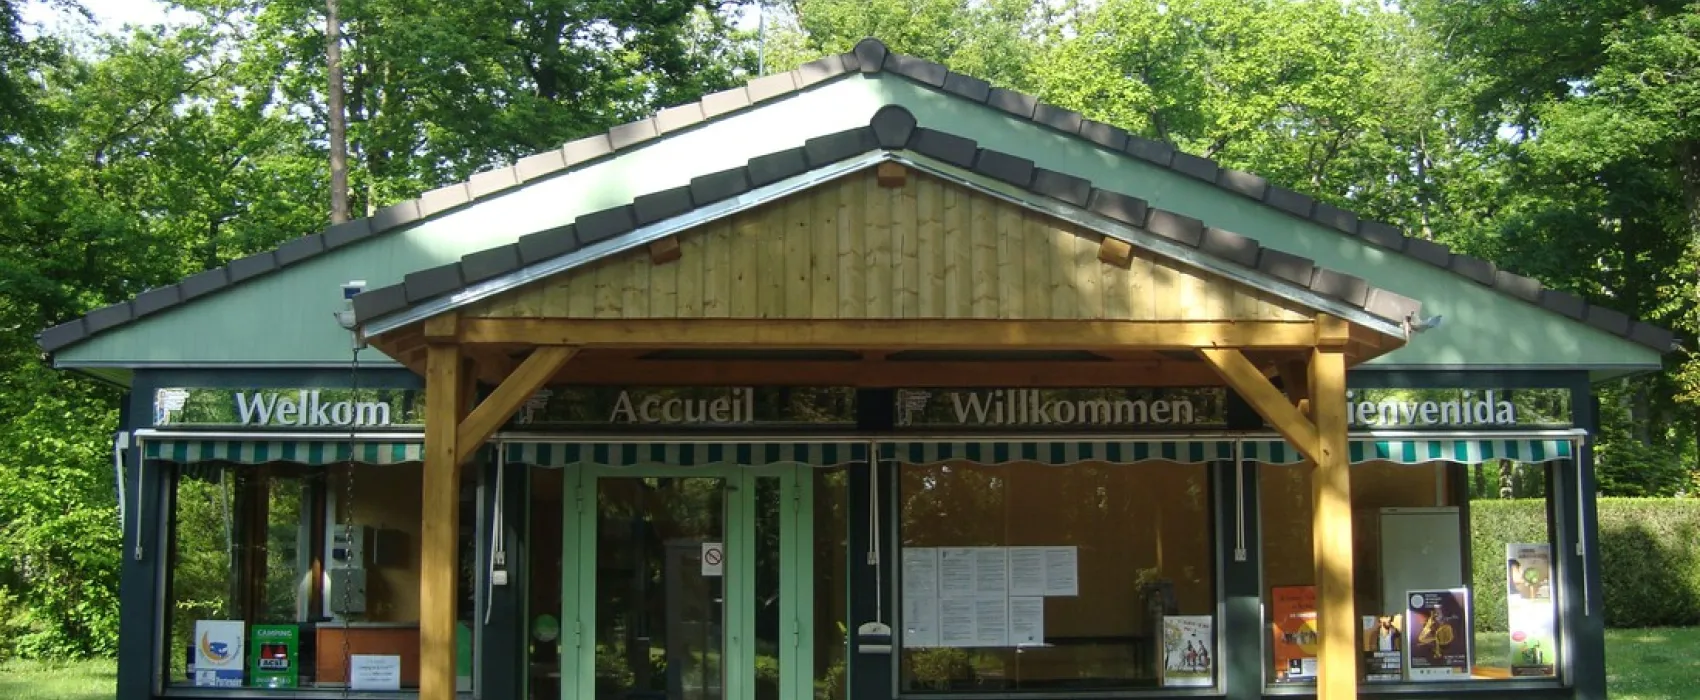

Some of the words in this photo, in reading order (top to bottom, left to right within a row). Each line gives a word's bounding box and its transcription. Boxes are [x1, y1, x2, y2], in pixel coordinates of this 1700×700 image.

[235, 389, 391, 426] Welkom
[609, 387, 754, 423] Accueil
[951, 388, 1194, 424] Willkommen
[1346, 389, 1516, 425] ienvenida
